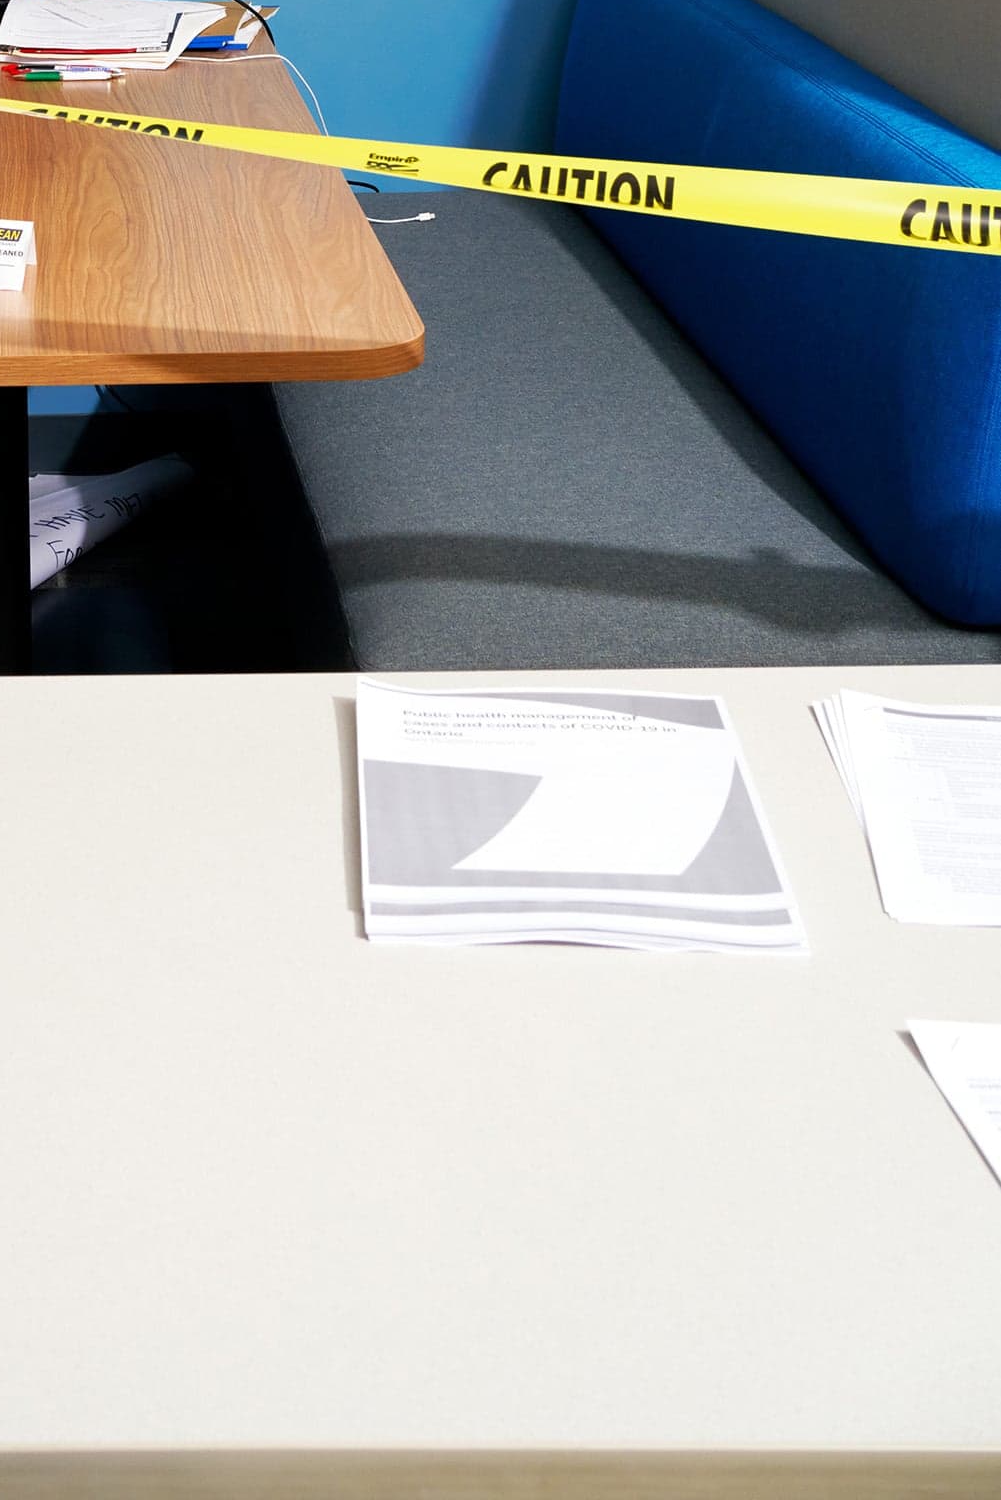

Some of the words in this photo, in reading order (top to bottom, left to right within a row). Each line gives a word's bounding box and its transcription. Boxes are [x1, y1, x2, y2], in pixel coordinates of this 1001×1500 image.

[482, 162, 676, 210] CAUTION
[621, 714, 638, 722] of
[560, 722, 578, 730] of
[580, 723, 658, 733] COVID-19
